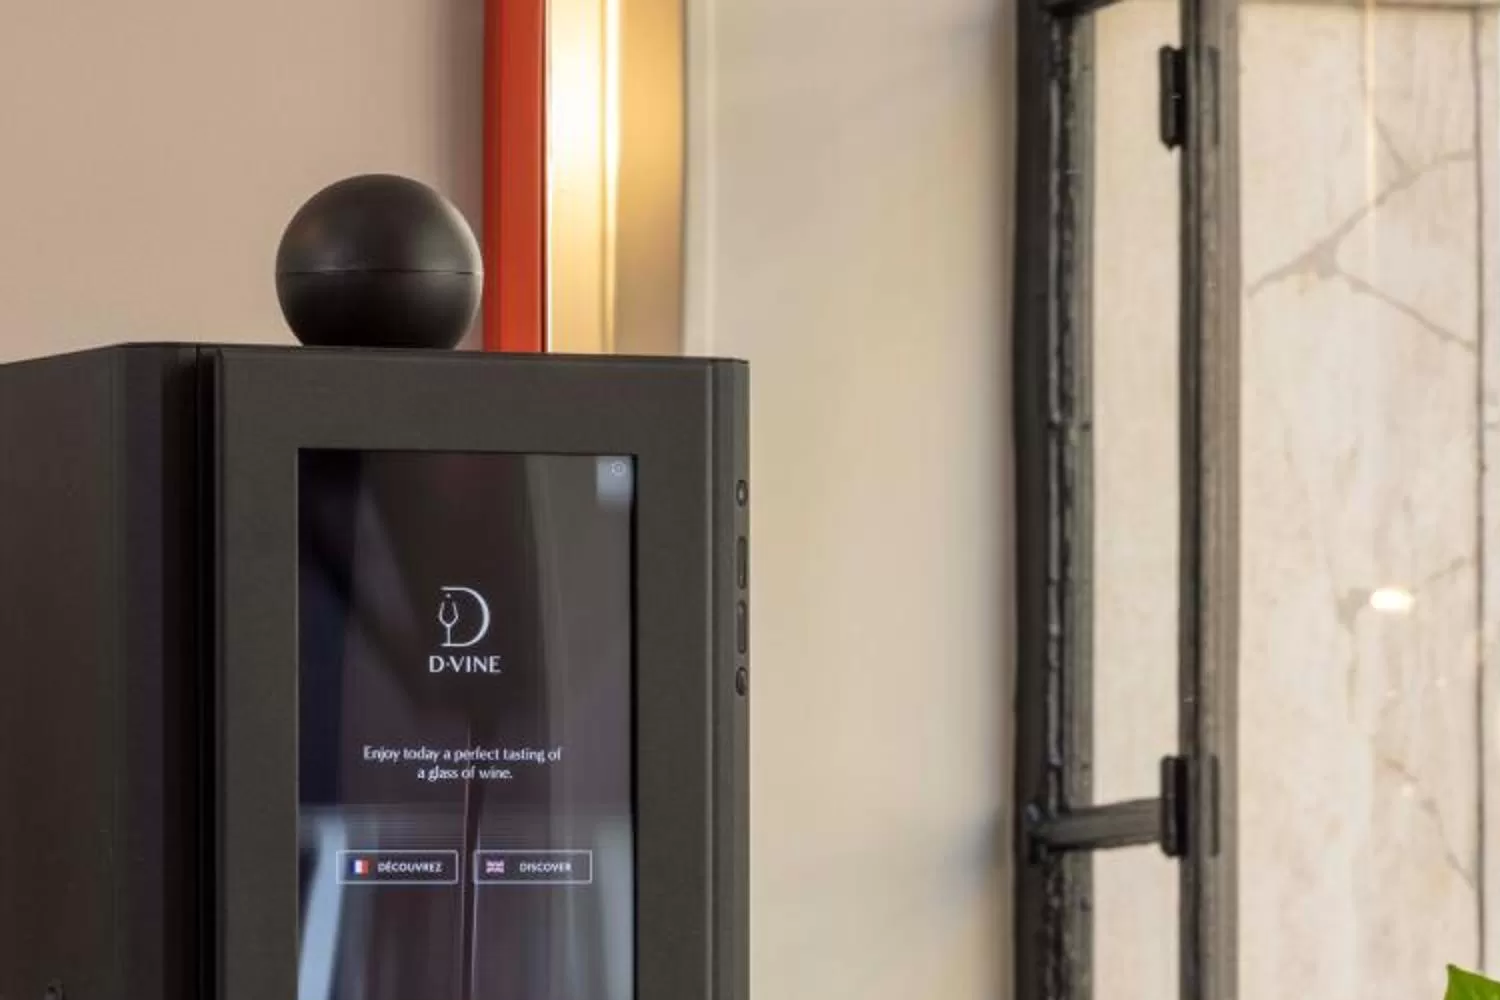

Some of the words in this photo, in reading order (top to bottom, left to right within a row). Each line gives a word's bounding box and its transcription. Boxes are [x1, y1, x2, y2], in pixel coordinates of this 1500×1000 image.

[363, 746, 400, 763] Enjoy
[403, 746, 438, 763] today
[442, 750, 452, 761] a
[453, 746, 500, 764] perfect
[503, 747, 545, 764] tasting
[547, 746, 563, 762] of
[417, 769, 426, 779] a
[428, 766, 459, 782] glass
[461, 765, 476, 780] of
[479, 767, 513, 780] wine.
[377, 859, 444, 874] DÉCOUVREZ
[519, 862, 573, 874] DISCOVER
